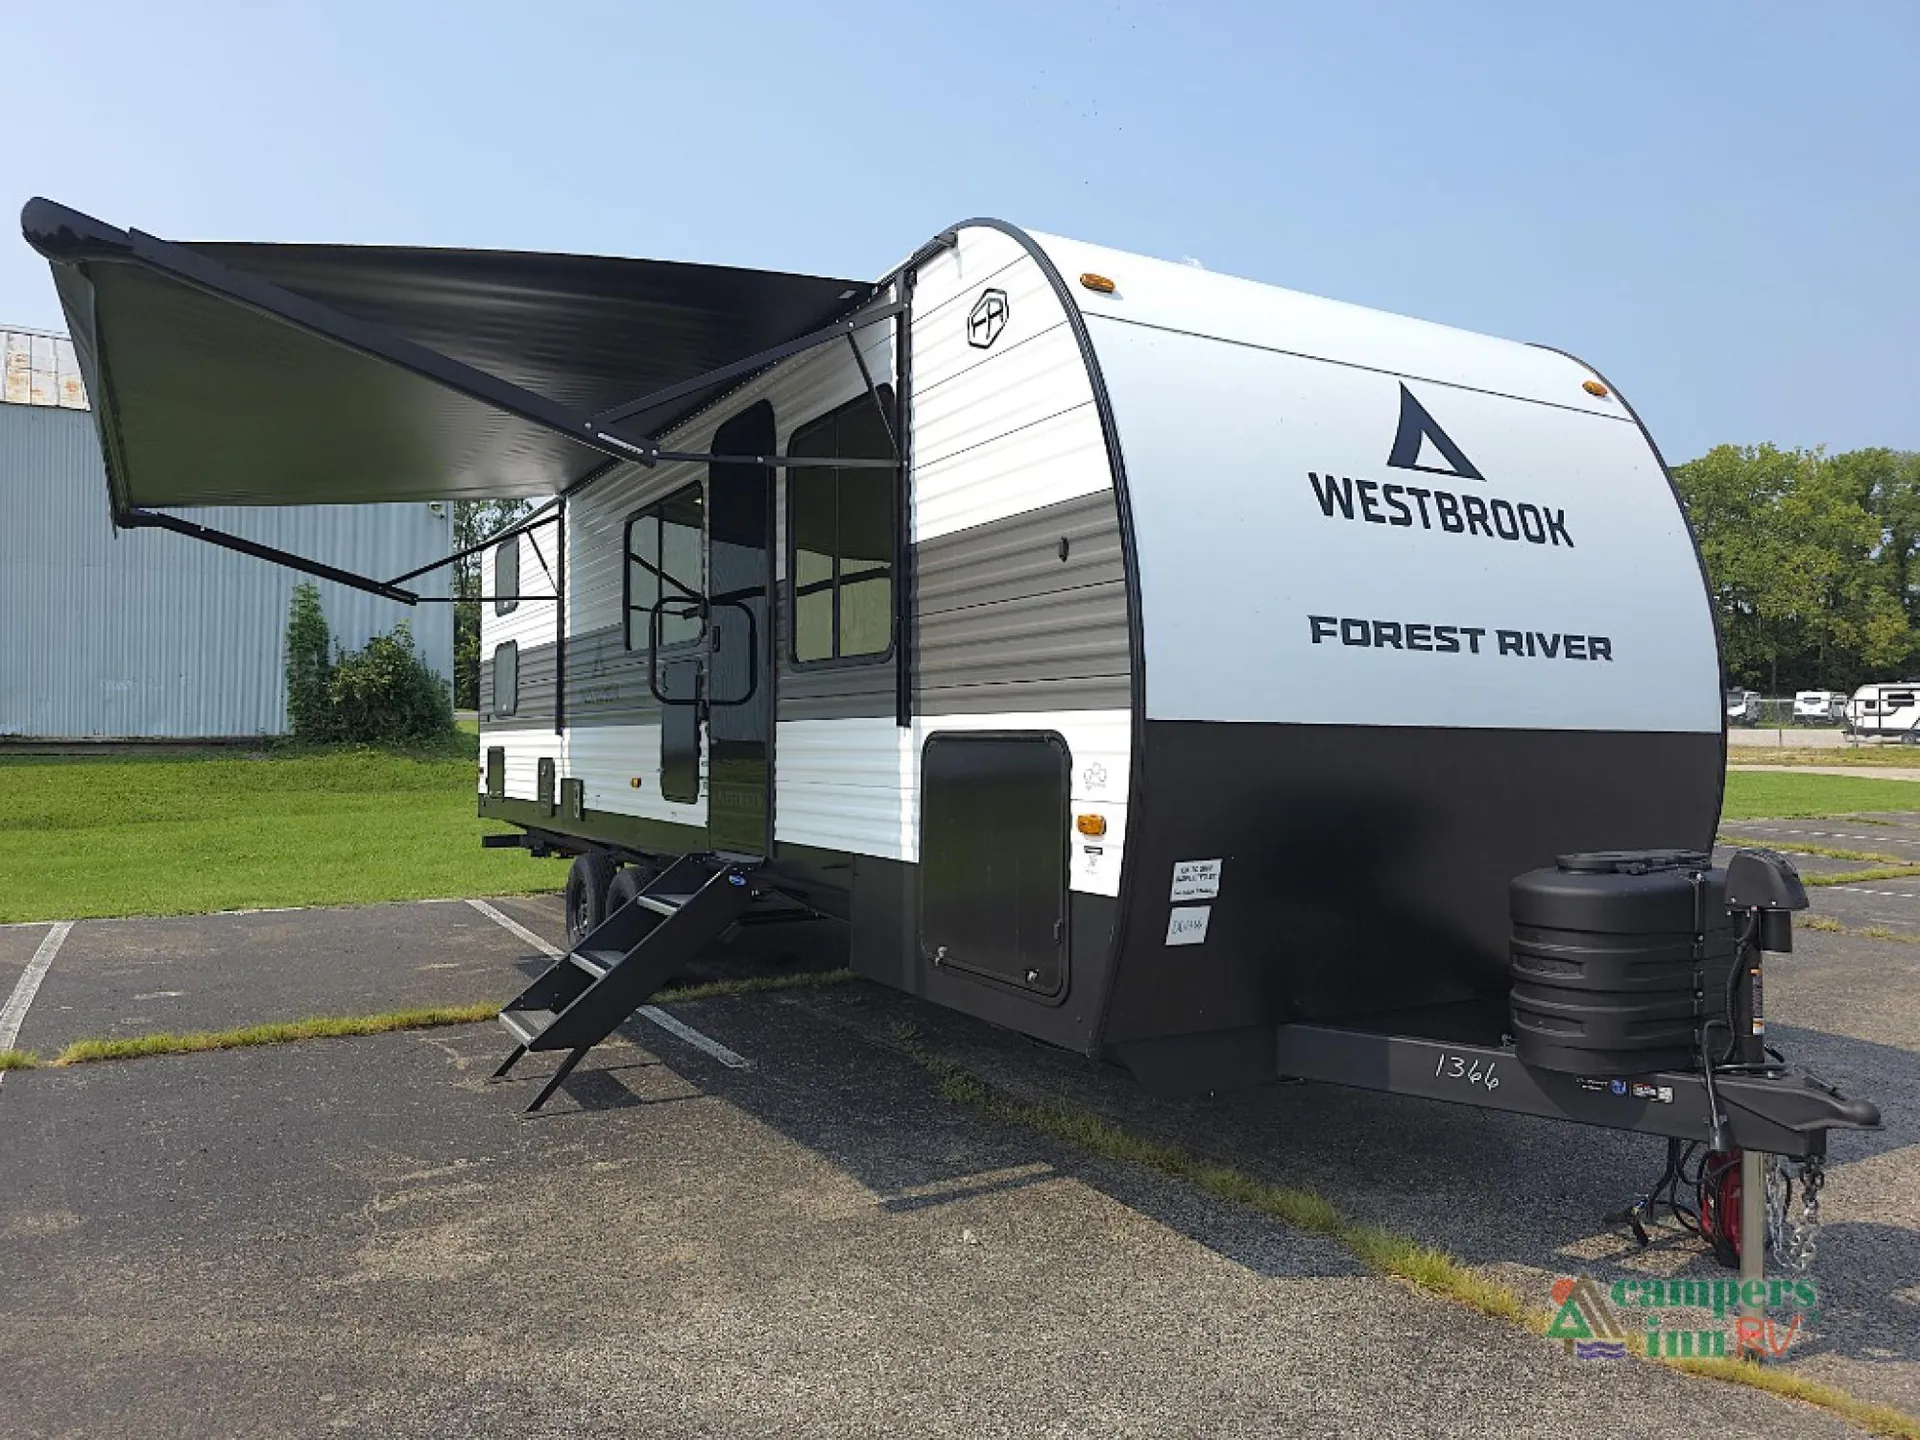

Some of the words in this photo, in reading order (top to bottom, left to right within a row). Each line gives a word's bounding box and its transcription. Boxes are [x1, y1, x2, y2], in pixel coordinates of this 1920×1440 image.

[1308, 471, 1575, 548] WESTBROOK
[1307, 614, 1486, 654] FOREST
[1495, 629, 1613, 662] RIVER
[1435, 1053, 1499, 1091] 1366
